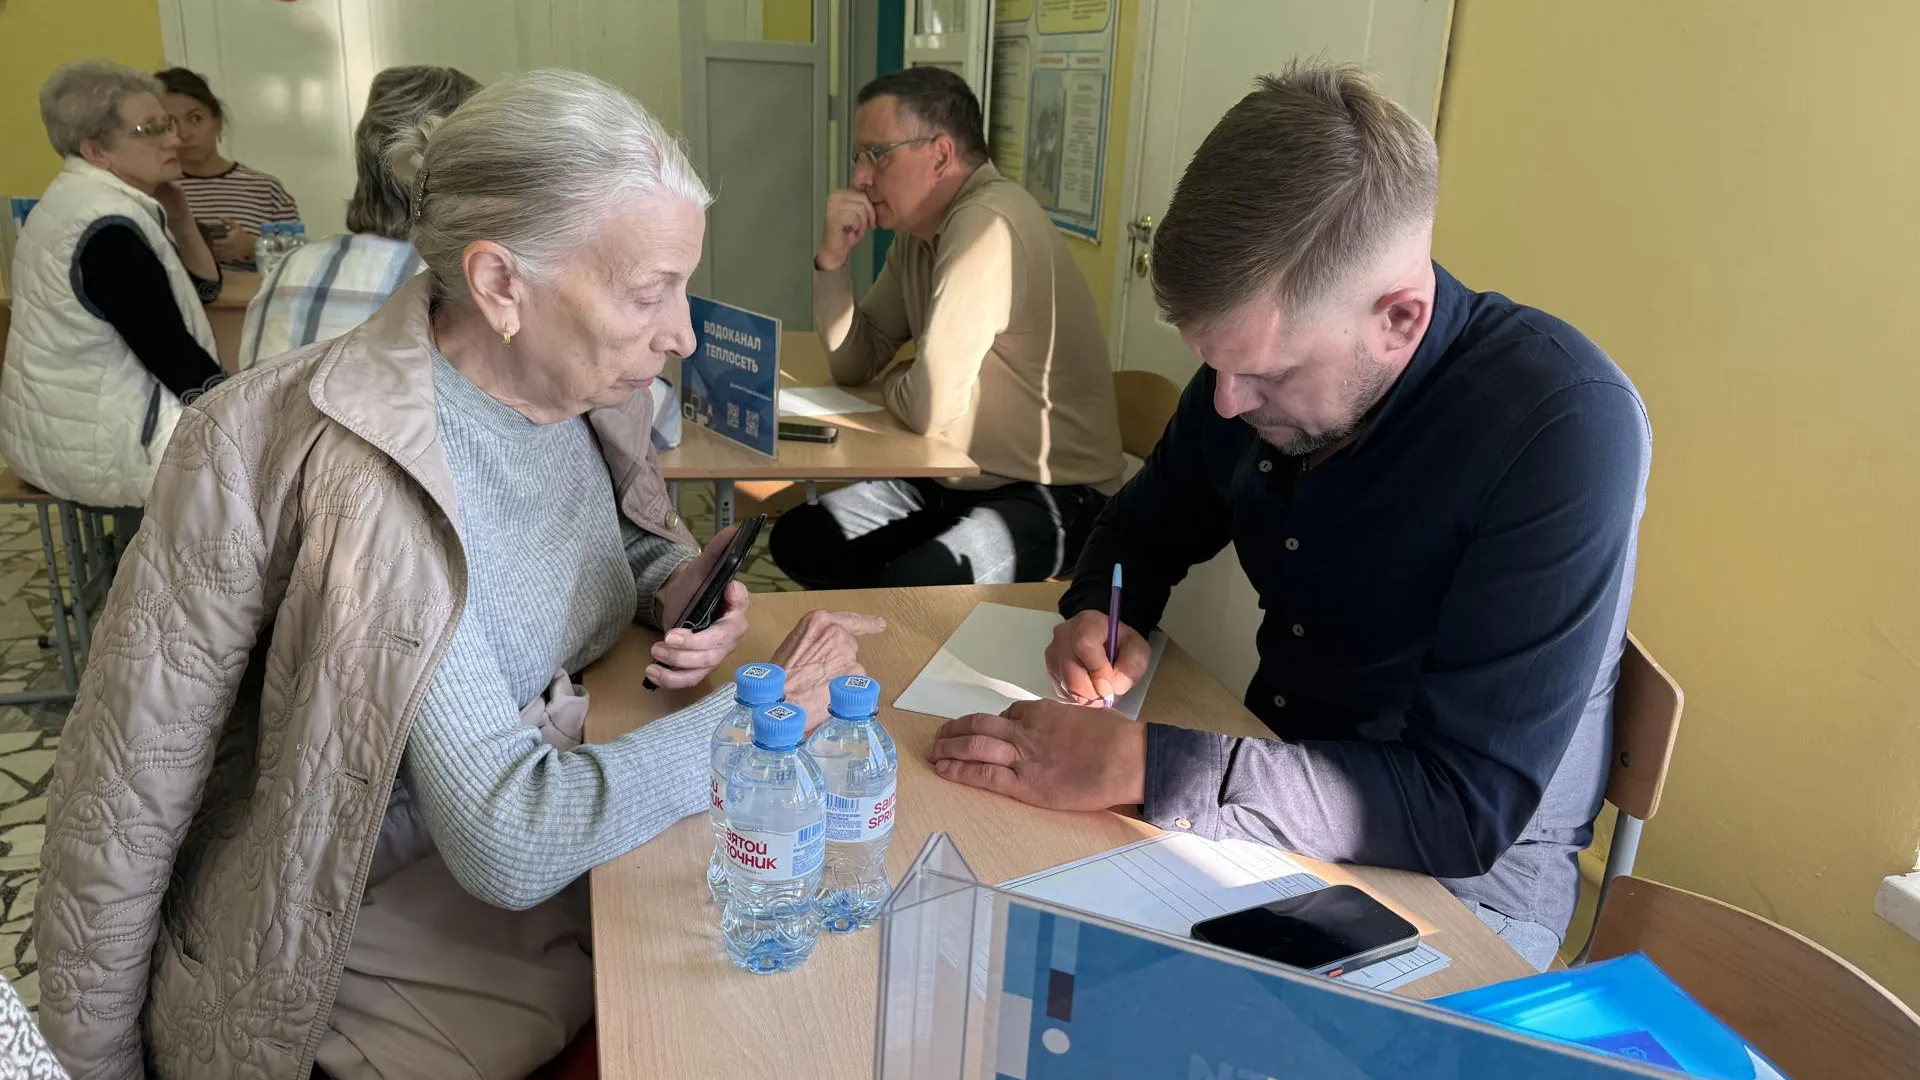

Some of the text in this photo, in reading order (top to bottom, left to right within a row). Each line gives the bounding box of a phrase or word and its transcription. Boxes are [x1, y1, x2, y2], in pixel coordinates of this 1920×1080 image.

[703, 320, 761, 352] ВОДОКАНАЛ
[704, 342, 759, 374] ТЕПЛОСЕТЬ
[725, 840, 778, 870] ТОЧНИК
[726, 827, 767, 855] ВЯТОЙ
